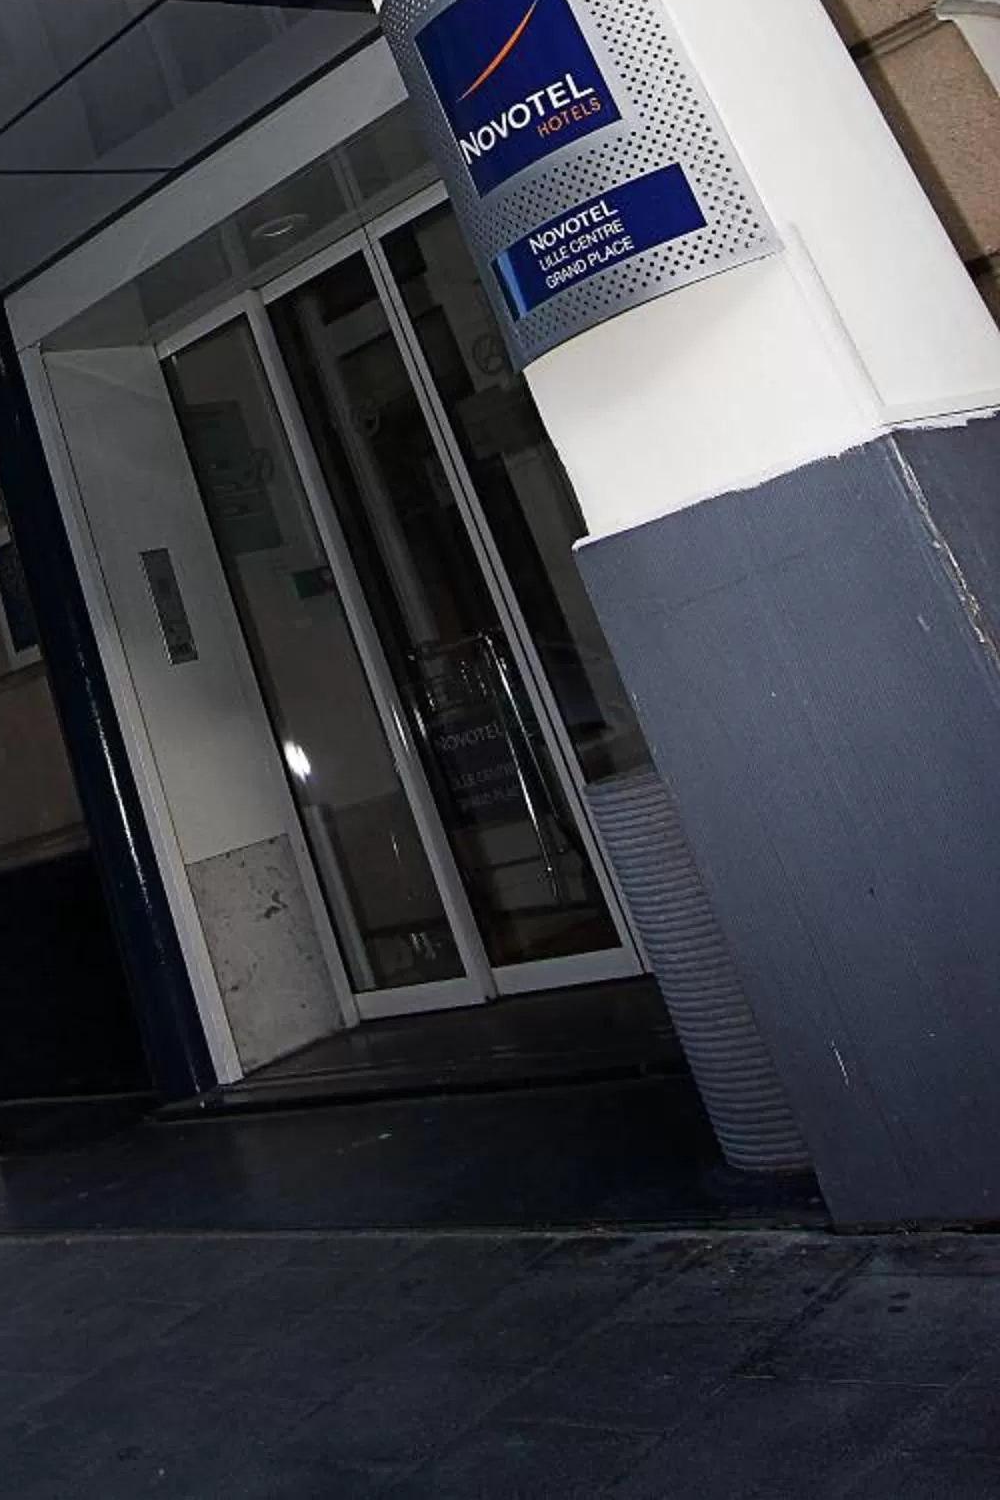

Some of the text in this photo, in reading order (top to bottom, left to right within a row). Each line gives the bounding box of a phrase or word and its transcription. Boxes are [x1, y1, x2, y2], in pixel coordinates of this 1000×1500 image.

[459, 73, 595, 165] NOVOTEL
[536, 97, 601, 138] HOTELS
[529, 200, 618, 255] NOVOTEL
[539, 218, 625, 272] LILLE CENTRE
[545, 235, 635, 289] GRAND PLACE
